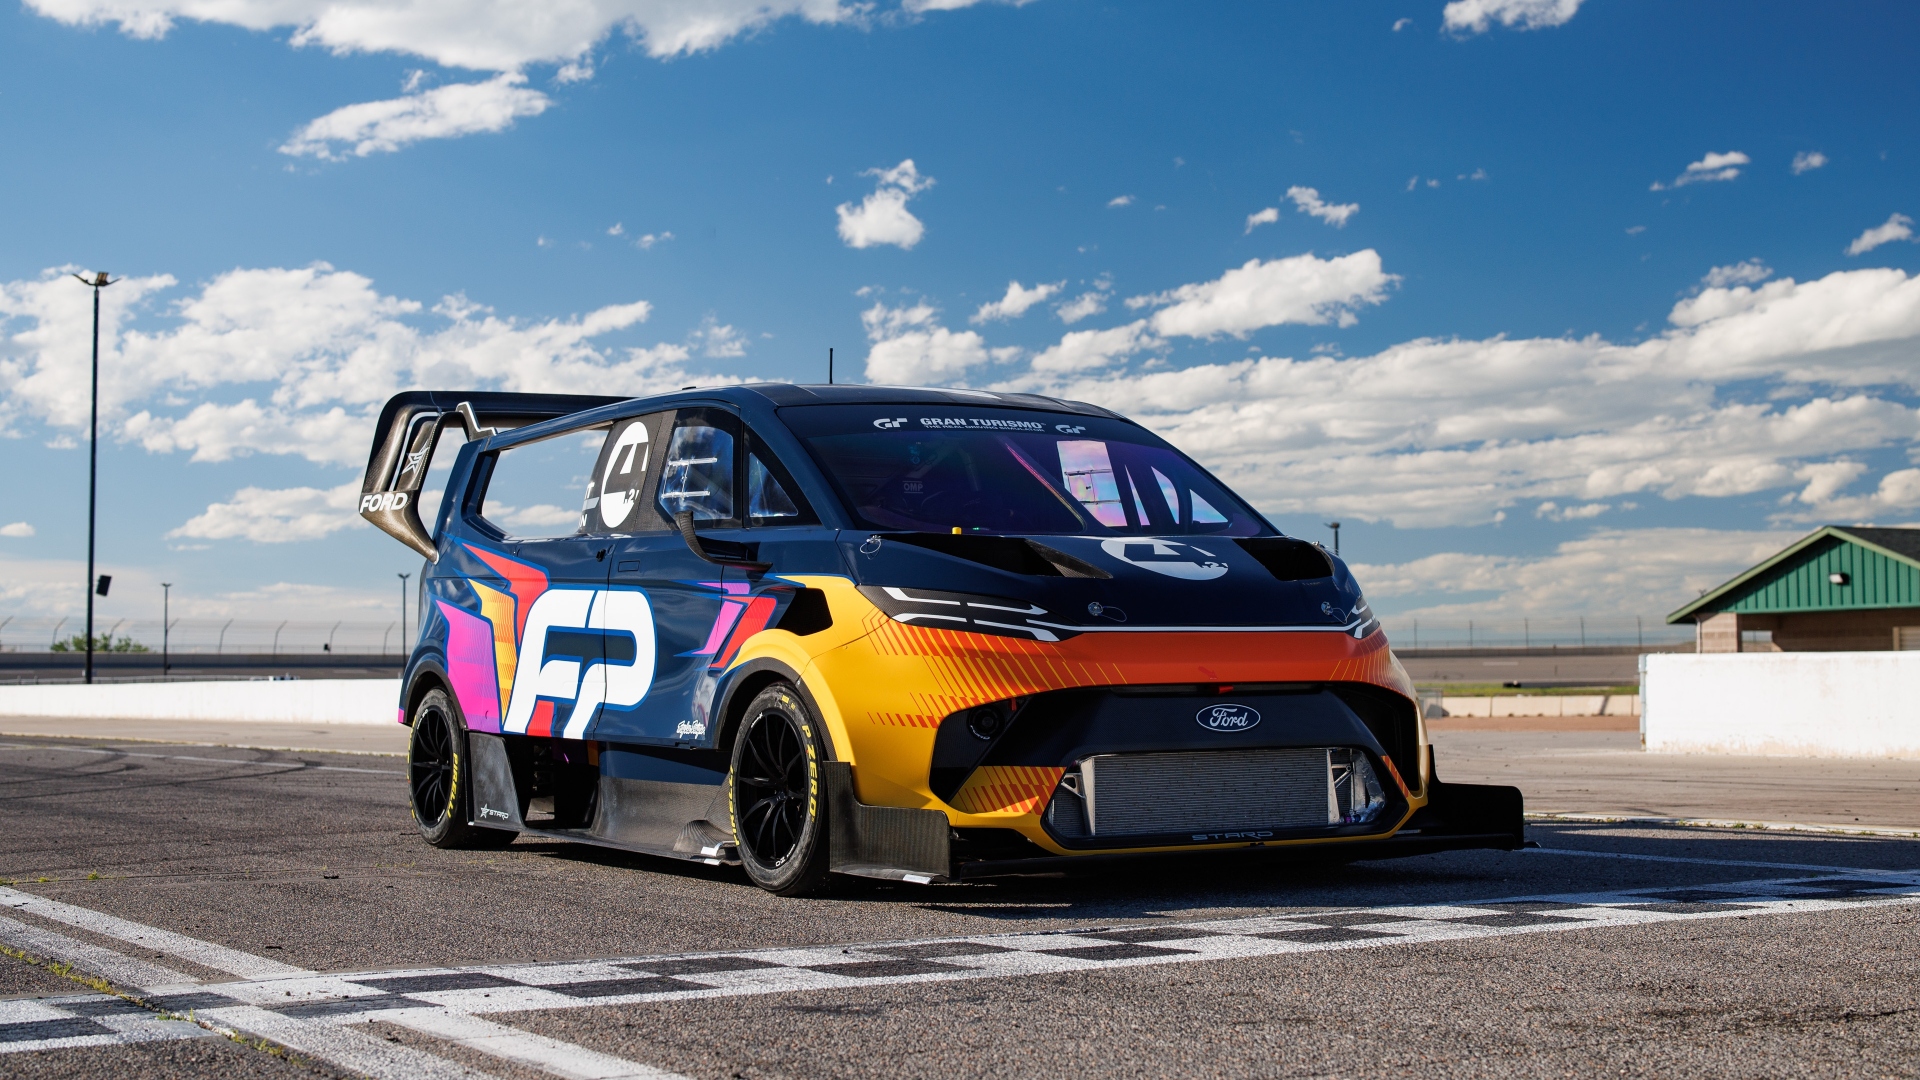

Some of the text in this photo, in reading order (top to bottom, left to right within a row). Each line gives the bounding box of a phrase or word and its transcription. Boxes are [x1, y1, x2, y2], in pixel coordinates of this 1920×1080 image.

[920, 417, 967, 426] GRAN
[903, 482, 924, 492] OMP
[360, 492, 409, 513] FORD
[503, 588, 656, 740] FP
[1209, 707, 1249, 727] Ford
[447, 752, 459, 819] PIRELLI
[806, 743, 818, 818] ZERO
[1192, 831, 1274, 841] STARD
